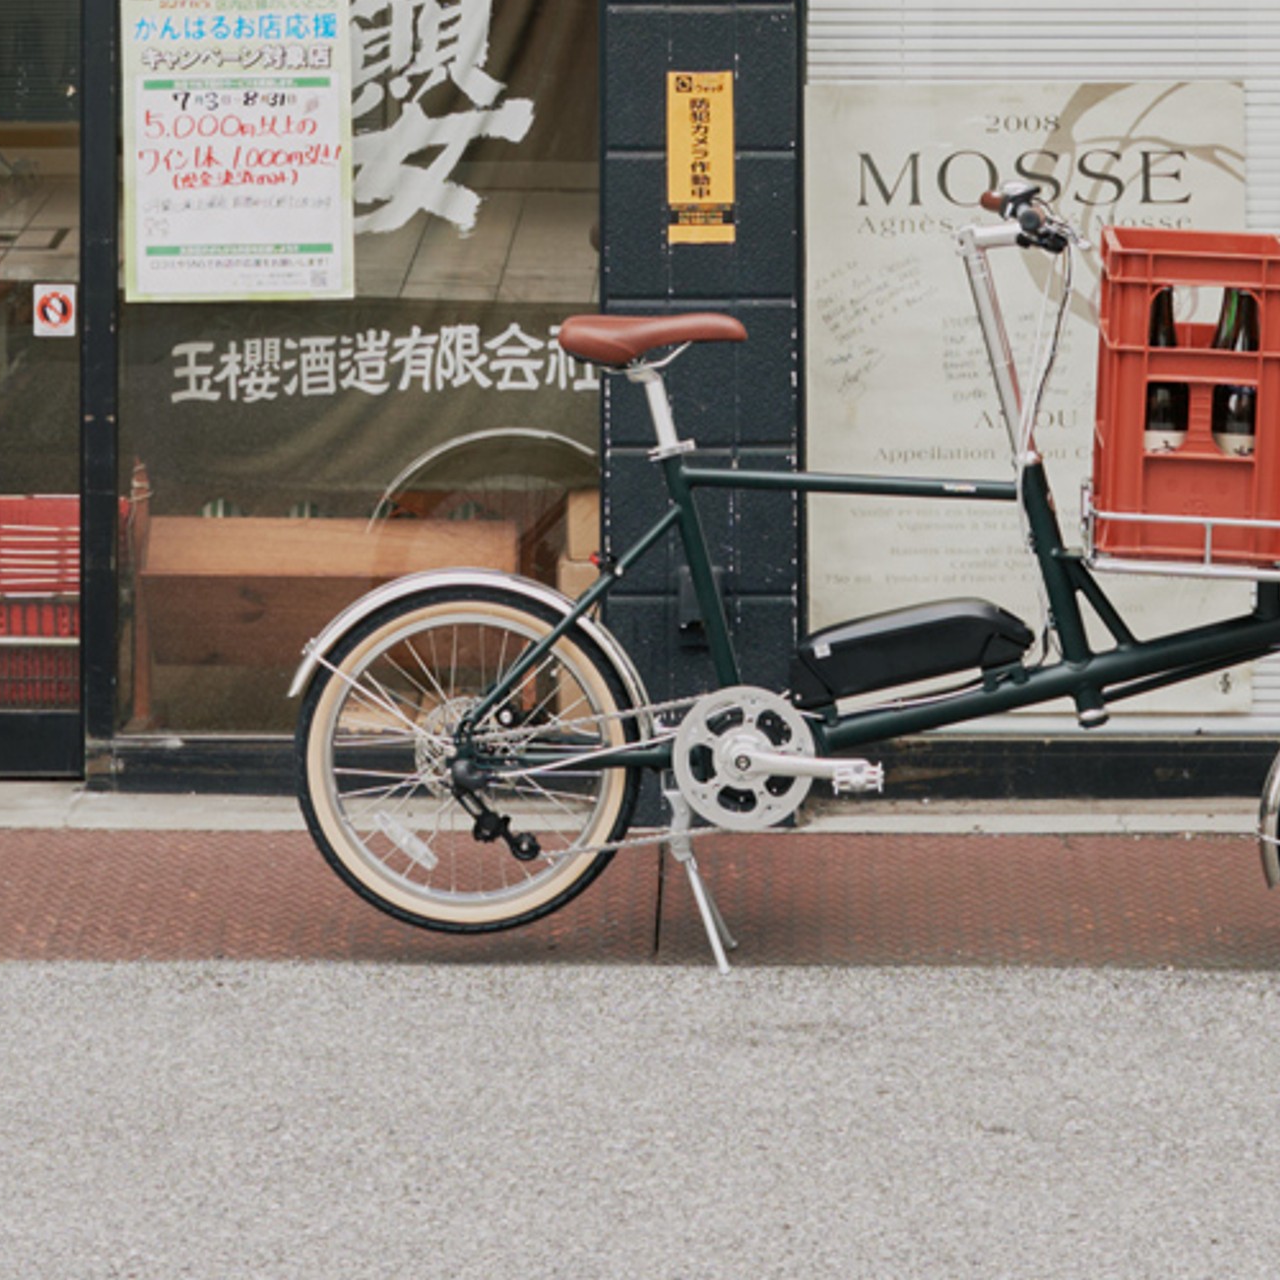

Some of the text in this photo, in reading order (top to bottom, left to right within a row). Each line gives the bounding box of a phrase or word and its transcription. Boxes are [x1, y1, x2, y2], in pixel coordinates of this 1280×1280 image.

[141, 43, 332, 71] キャンペーン対象店
[984, 114, 1061, 134] 2008
[857, 149, 1192, 208] MOSSE
[874, 446, 996, 464] Appellation
